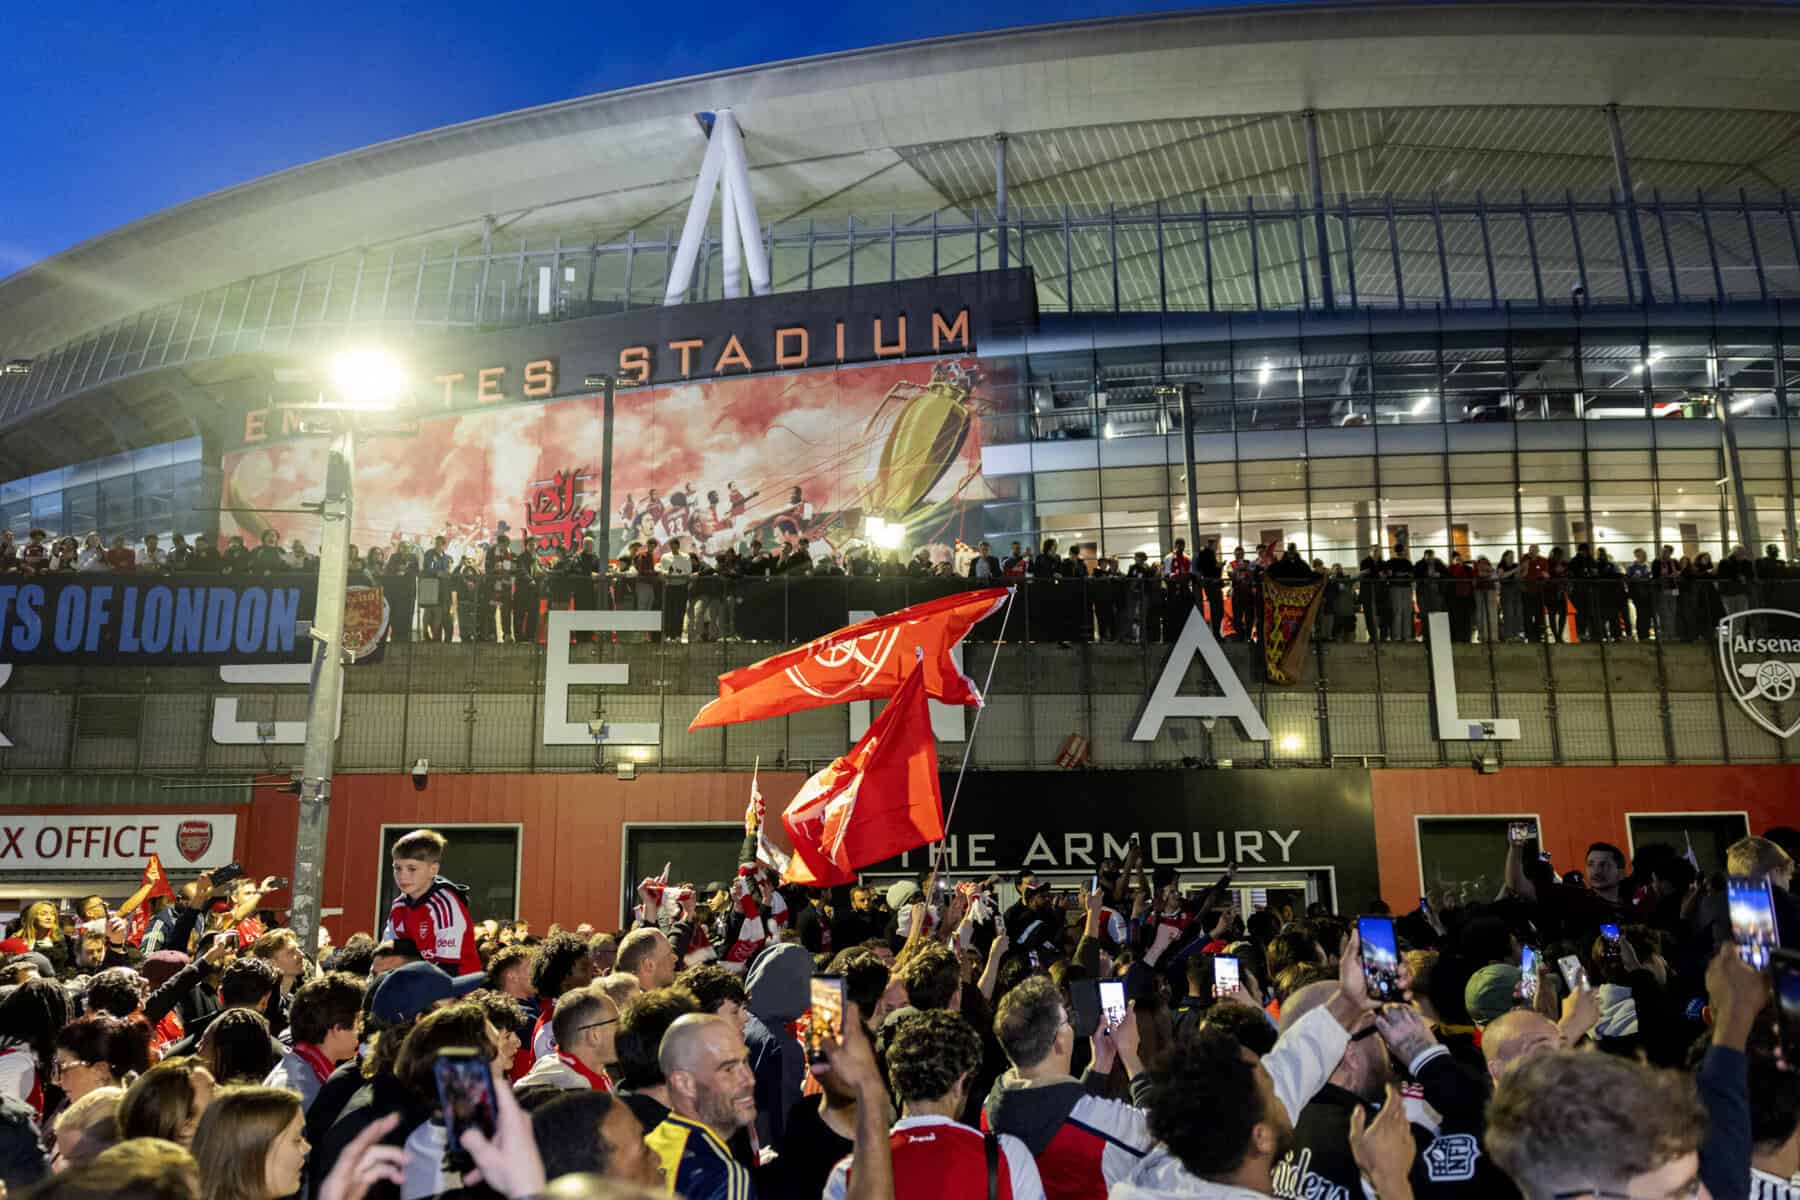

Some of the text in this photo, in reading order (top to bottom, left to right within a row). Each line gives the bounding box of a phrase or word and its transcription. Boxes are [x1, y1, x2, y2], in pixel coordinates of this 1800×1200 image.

[244, 310, 970, 441] EMTES STADIUM
[55, 585, 113, 653] OF
[119, 586, 300, 654] LONDON
[0, 825, 159, 858] X OFFICE
[903, 830, 1301, 867] HE ARMOURY
